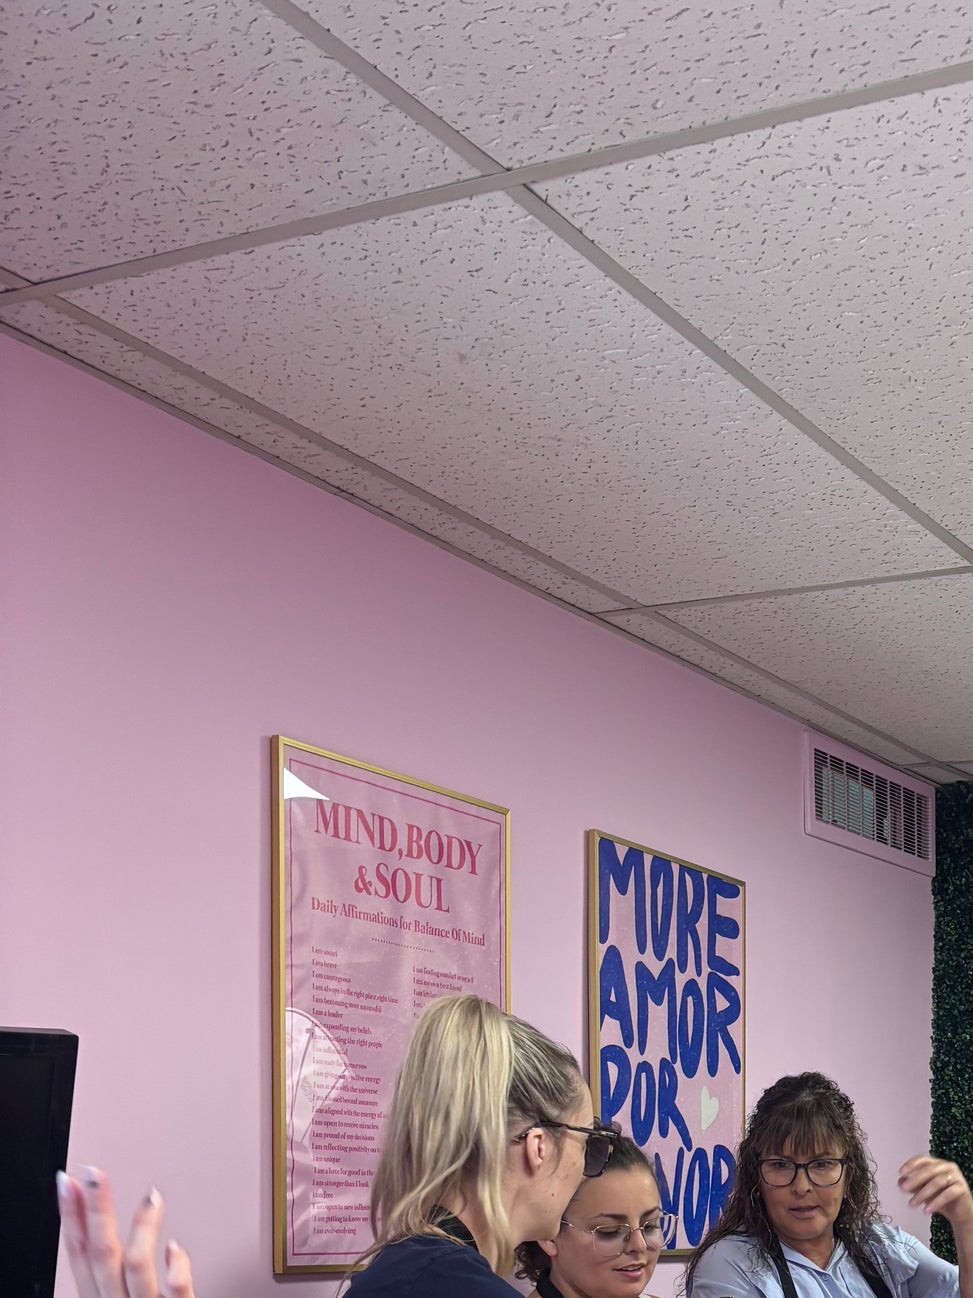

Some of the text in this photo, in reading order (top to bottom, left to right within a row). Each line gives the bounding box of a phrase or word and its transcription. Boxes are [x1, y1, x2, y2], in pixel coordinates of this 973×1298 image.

[599, 837, 741, 977] MORE
[311, 896, 486, 947] Daily Affirmations for Balance Of Mind
[599, 944, 742, 1079] AMOR
[355, 1038, 368, 1047] right
[365, 1076, 381, 1084] energy
[600, 1043, 692, 1152] POR
[324, 1107, 344, 1116] aligned
[323, 1131, 340, 1140] proud
[323, 1143, 349, 1153] reflecting
[323, 1191, 334, 1199] free
[655, 1144, 738, 1250] VOR
